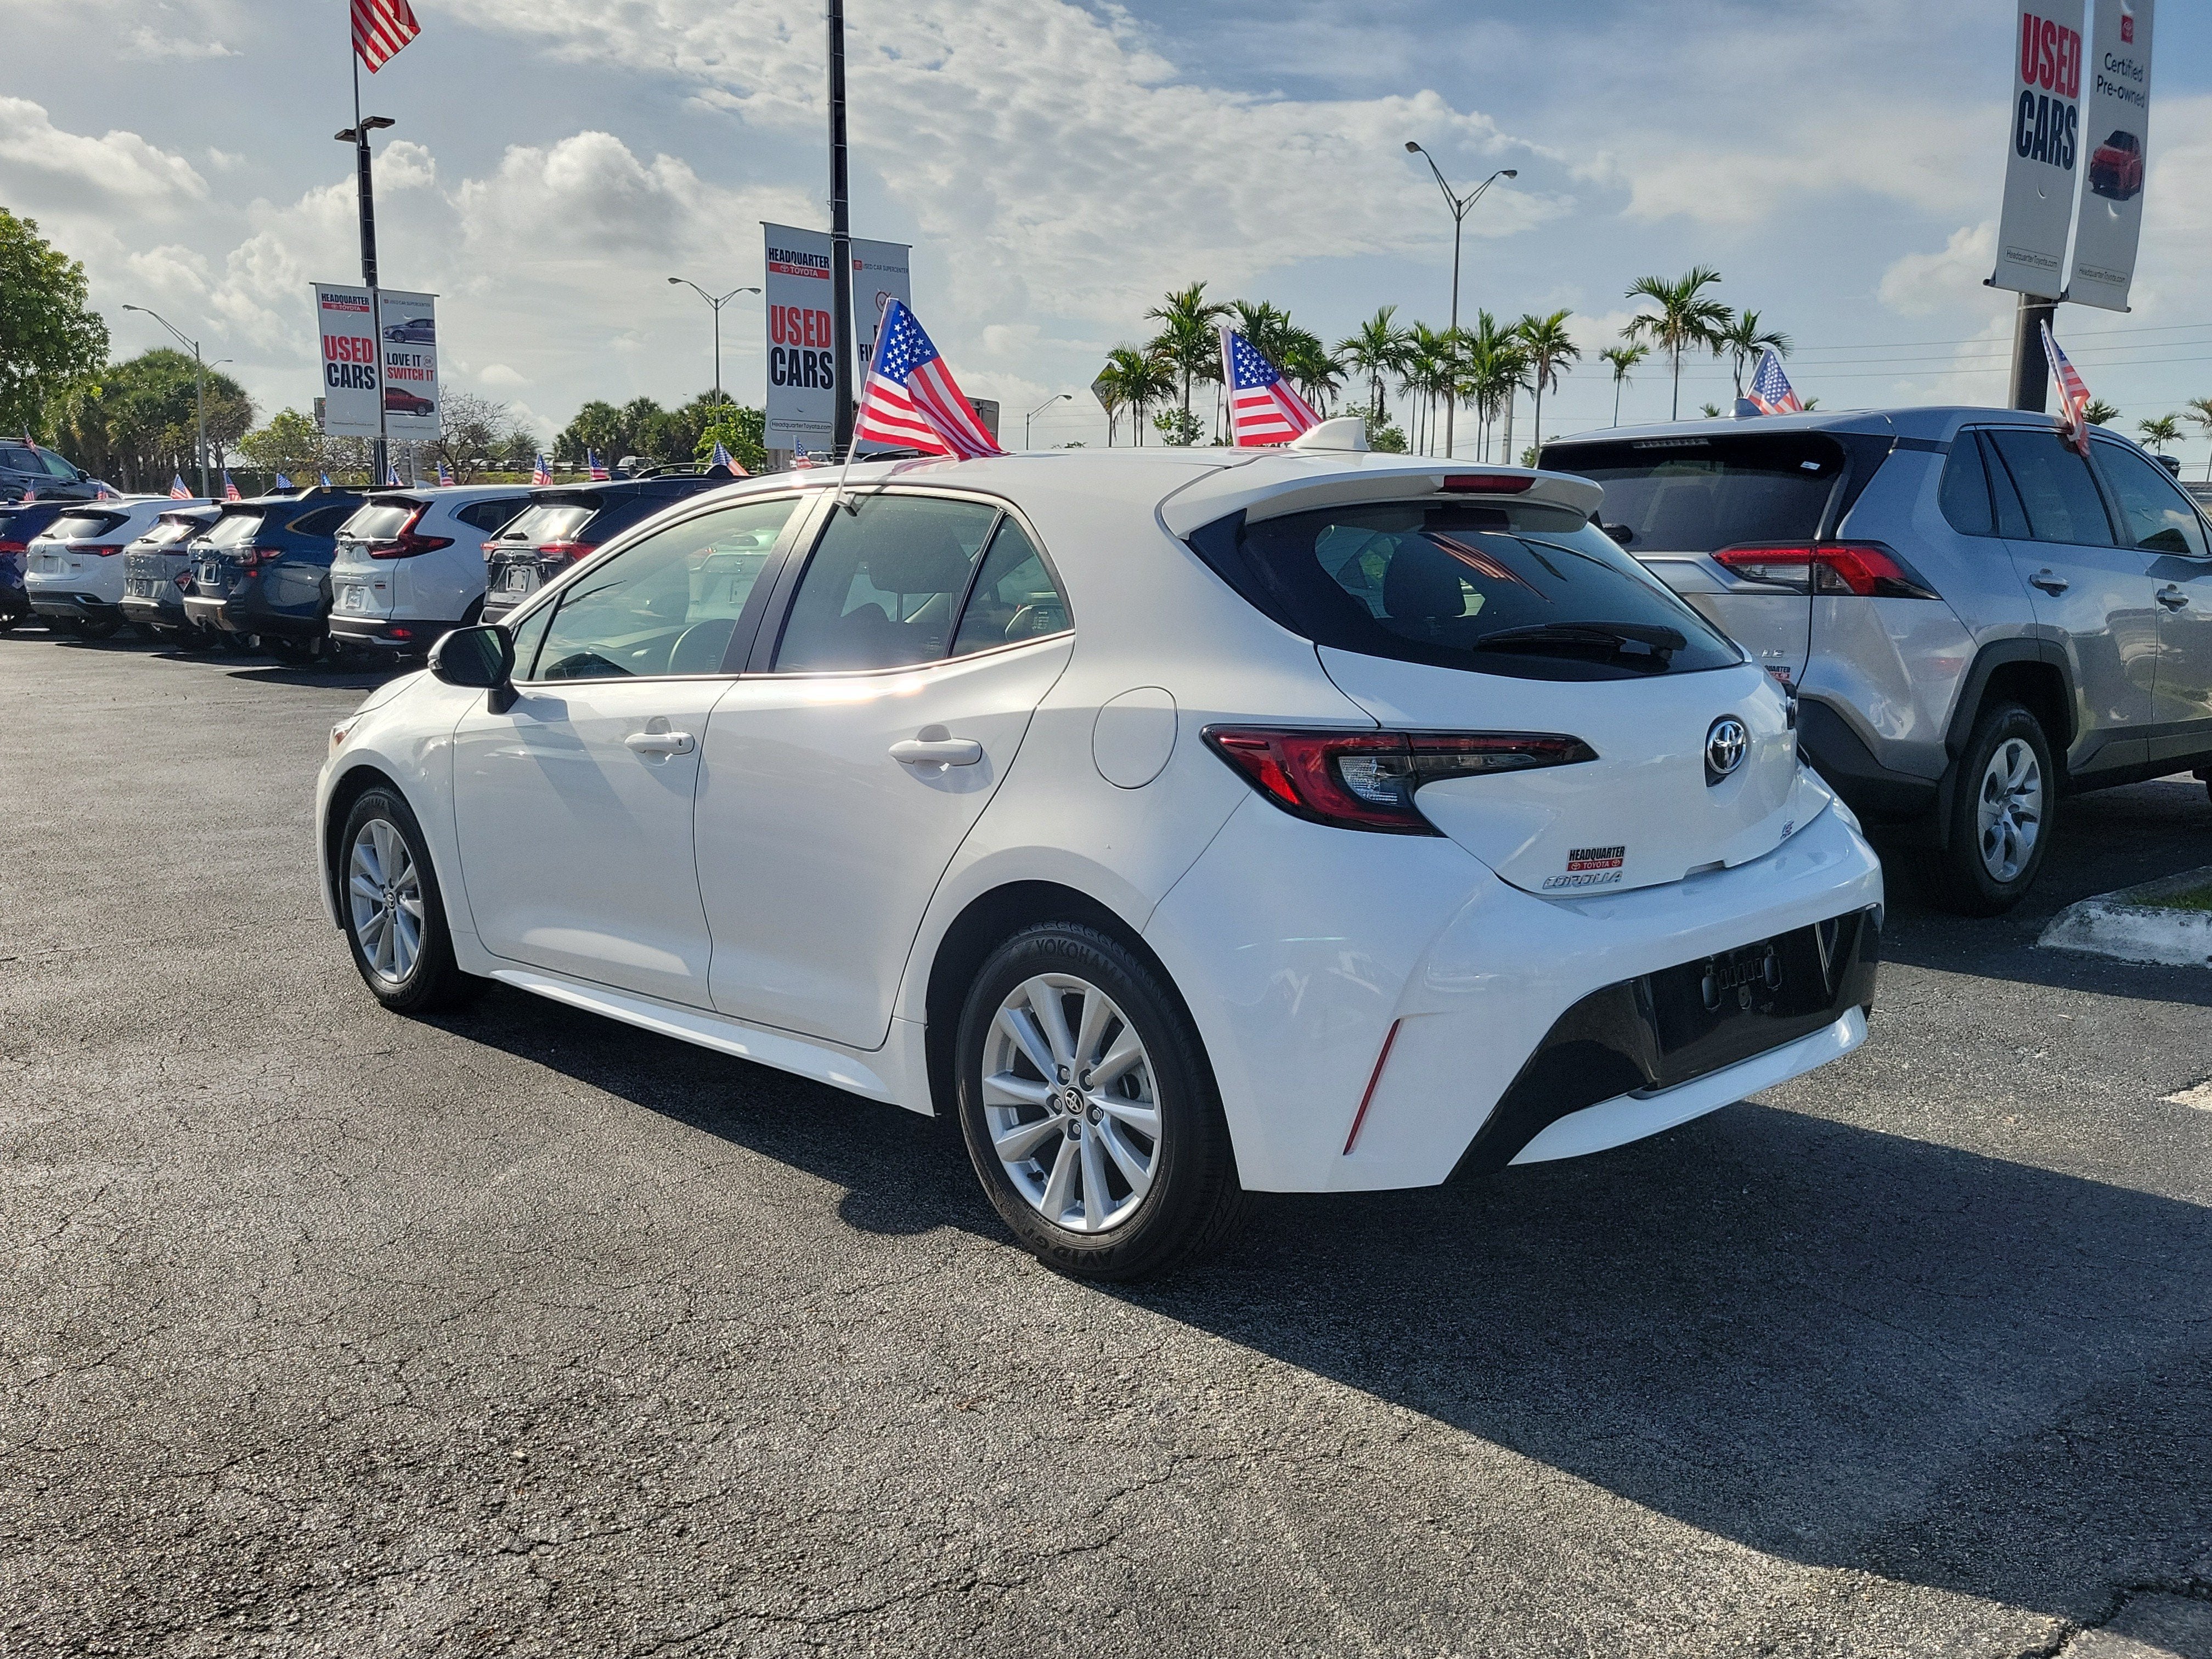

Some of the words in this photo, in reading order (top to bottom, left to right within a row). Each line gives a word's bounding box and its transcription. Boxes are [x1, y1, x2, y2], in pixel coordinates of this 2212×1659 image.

[2022, 13, 2080, 99] USED
[2104, 53, 2143, 83] Certified
[2096, 75, 2146, 109] Pre-owned
[2016, 90, 2077, 171] CARS
[768, 247, 830, 269] HEADQUARTER
[790, 266, 819, 278] TOYOTA
[321, 293, 369, 306] HEADQUARTER
[770, 305, 831, 348] USED
[324, 335, 374, 363] USED
[387, 352, 410, 366] LOVE
[413, 354, 421, 367] IT
[326, 363, 376, 390] CARS
[387, 366, 424, 381] SWITCH
[426, 369, 434, 382] IT
[770, 347, 834, 390] CARS
[1569, 846, 1625, 861] HEADQUARTER
[1542, 870, 1623, 890] COROLLA
